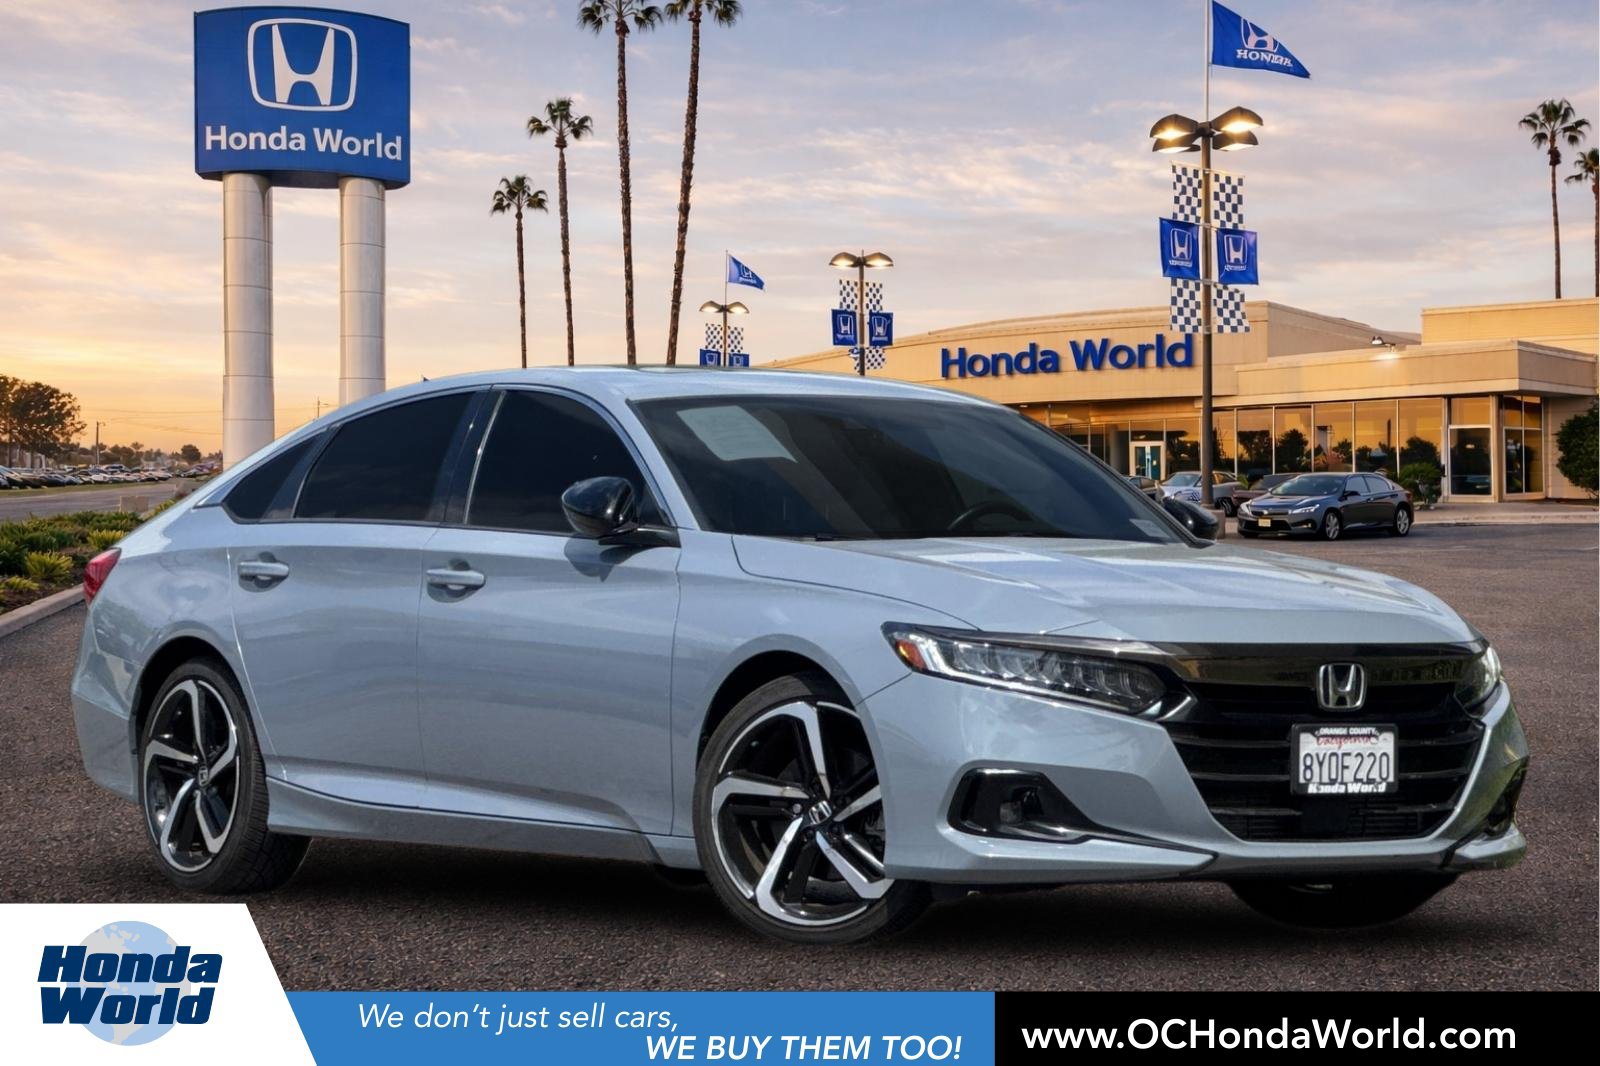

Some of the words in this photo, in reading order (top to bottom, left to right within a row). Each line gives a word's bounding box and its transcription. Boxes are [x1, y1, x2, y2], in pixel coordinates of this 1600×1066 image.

[205, 125, 306, 151] Honda
[313, 127, 402, 161] World
[941, 342, 1060, 379] Honda
[1070, 333, 1194, 371] World
